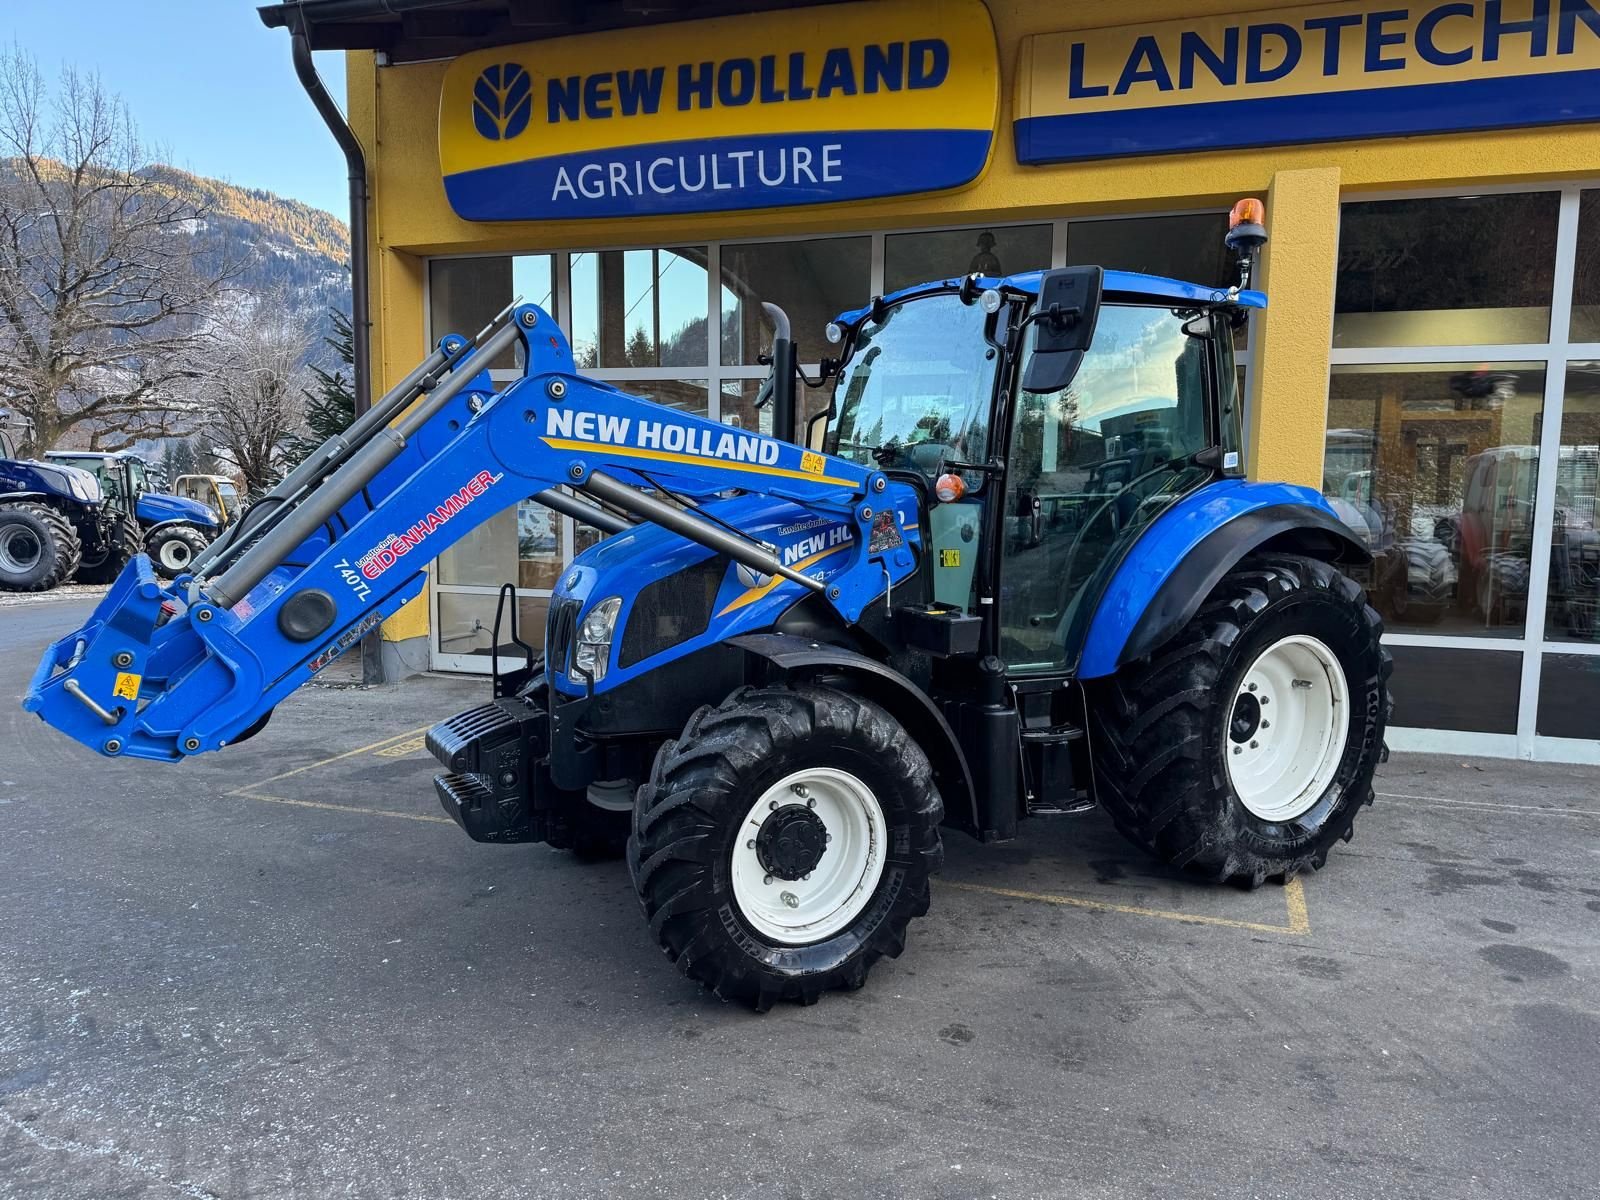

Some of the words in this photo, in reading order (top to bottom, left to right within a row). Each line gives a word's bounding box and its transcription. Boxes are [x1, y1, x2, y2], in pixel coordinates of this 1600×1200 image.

[547, 66, 665, 124] NEW
[678, 38, 949, 111] HOLLAND
[551, 144, 844, 201] AGRICULTURE
[546, 407, 631, 445] NEW
[637, 420, 780, 466] HOLLAND
[354, 532, 398, 569] Landtechnik
[361, 469, 496, 580] EIDENHAMMER
[784, 532, 826, 567] NEW
[333, 558, 375, 603] 740TL
